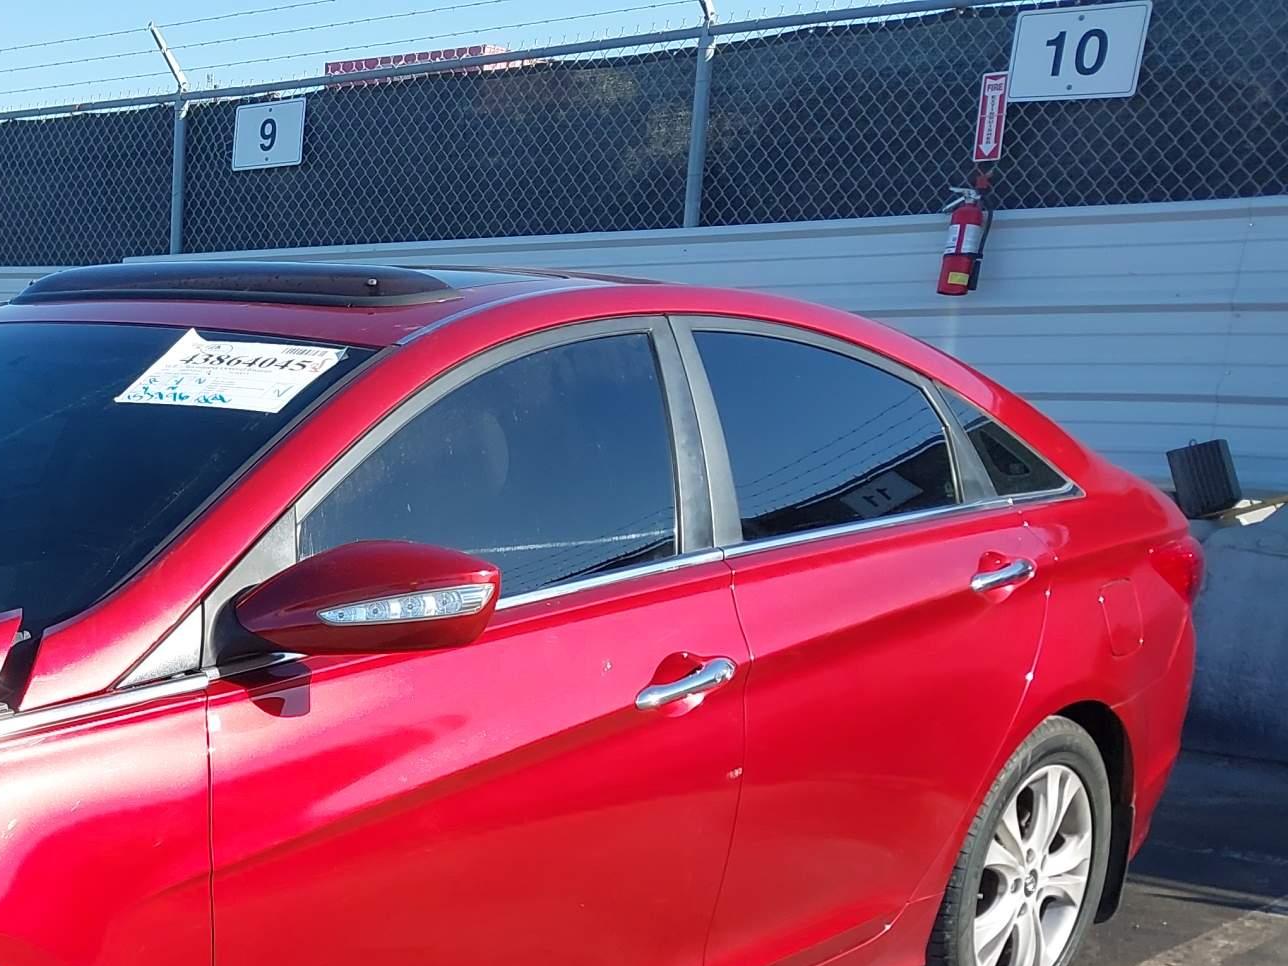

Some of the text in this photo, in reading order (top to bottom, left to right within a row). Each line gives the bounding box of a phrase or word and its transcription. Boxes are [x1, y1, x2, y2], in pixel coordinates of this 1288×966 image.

[1045, 28, 1109, 77] 10
[987, 83, 1004, 92] FIRE
[259, 118, 277, 151] 9
[180, 353, 313, 372] 43864045
